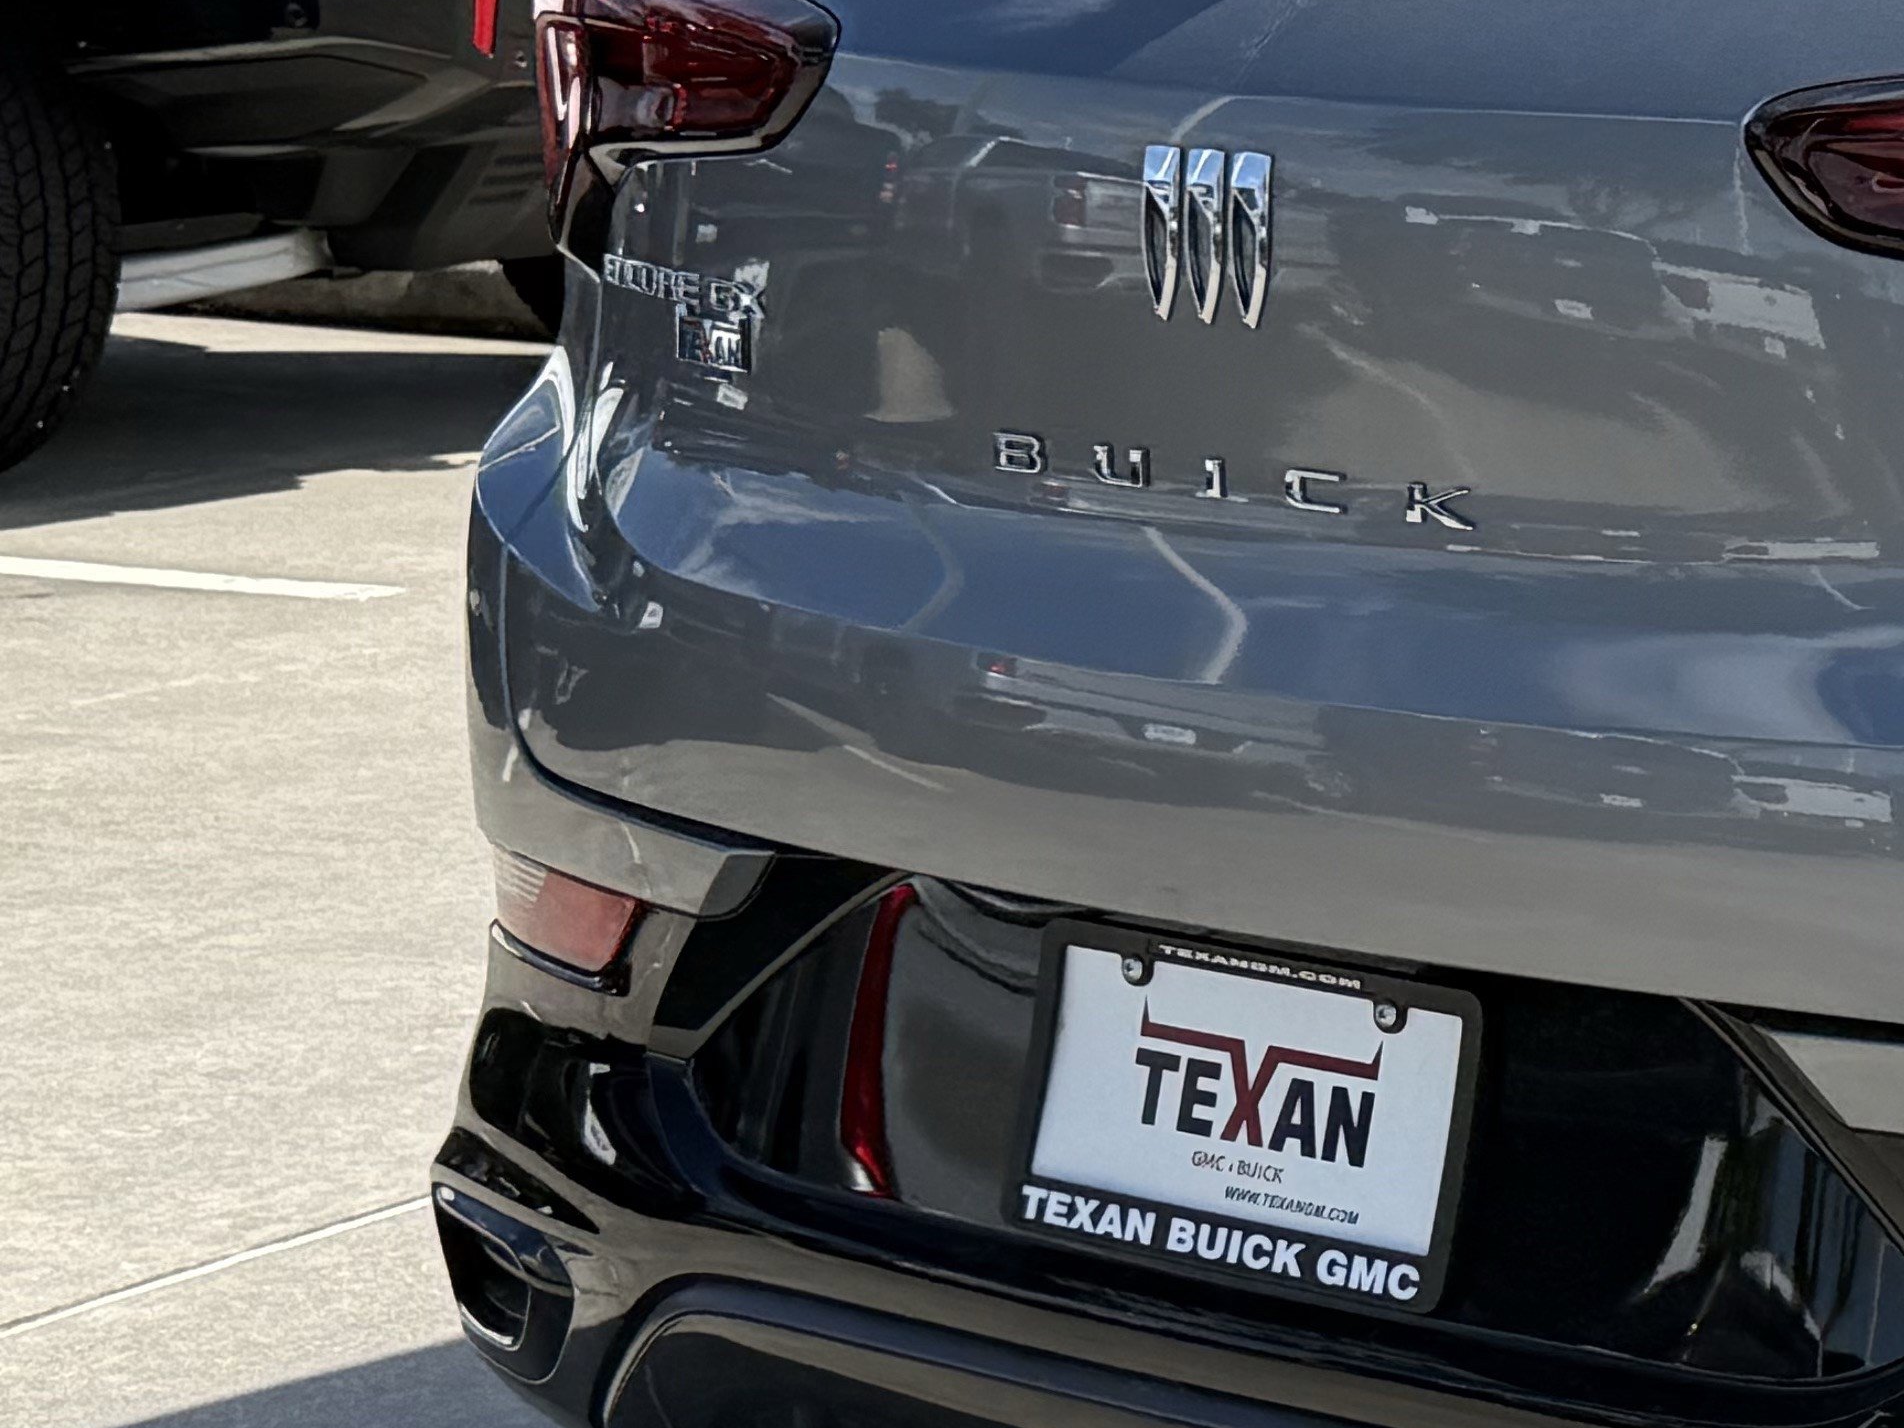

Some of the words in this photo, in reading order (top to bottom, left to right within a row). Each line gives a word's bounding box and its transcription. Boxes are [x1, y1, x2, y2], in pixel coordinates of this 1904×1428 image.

[994, 431, 1475, 531] BUICK
[1158, 943, 1362, 990] TEXANGM.COM
[1135, 996, 1384, 1169] TEXAN
[1191, 1150, 1226, 1173] GMC
[1237, 1159, 1285, 1184] BUICK
[1224, 1185, 1360, 1225] WWW.TEXANGM.COM
[1021, 1184, 1156, 1246] TEXAN
[1166, 1218, 1308, 1278] BUICK
[1316, 1247, 1421, 1302] GMC
